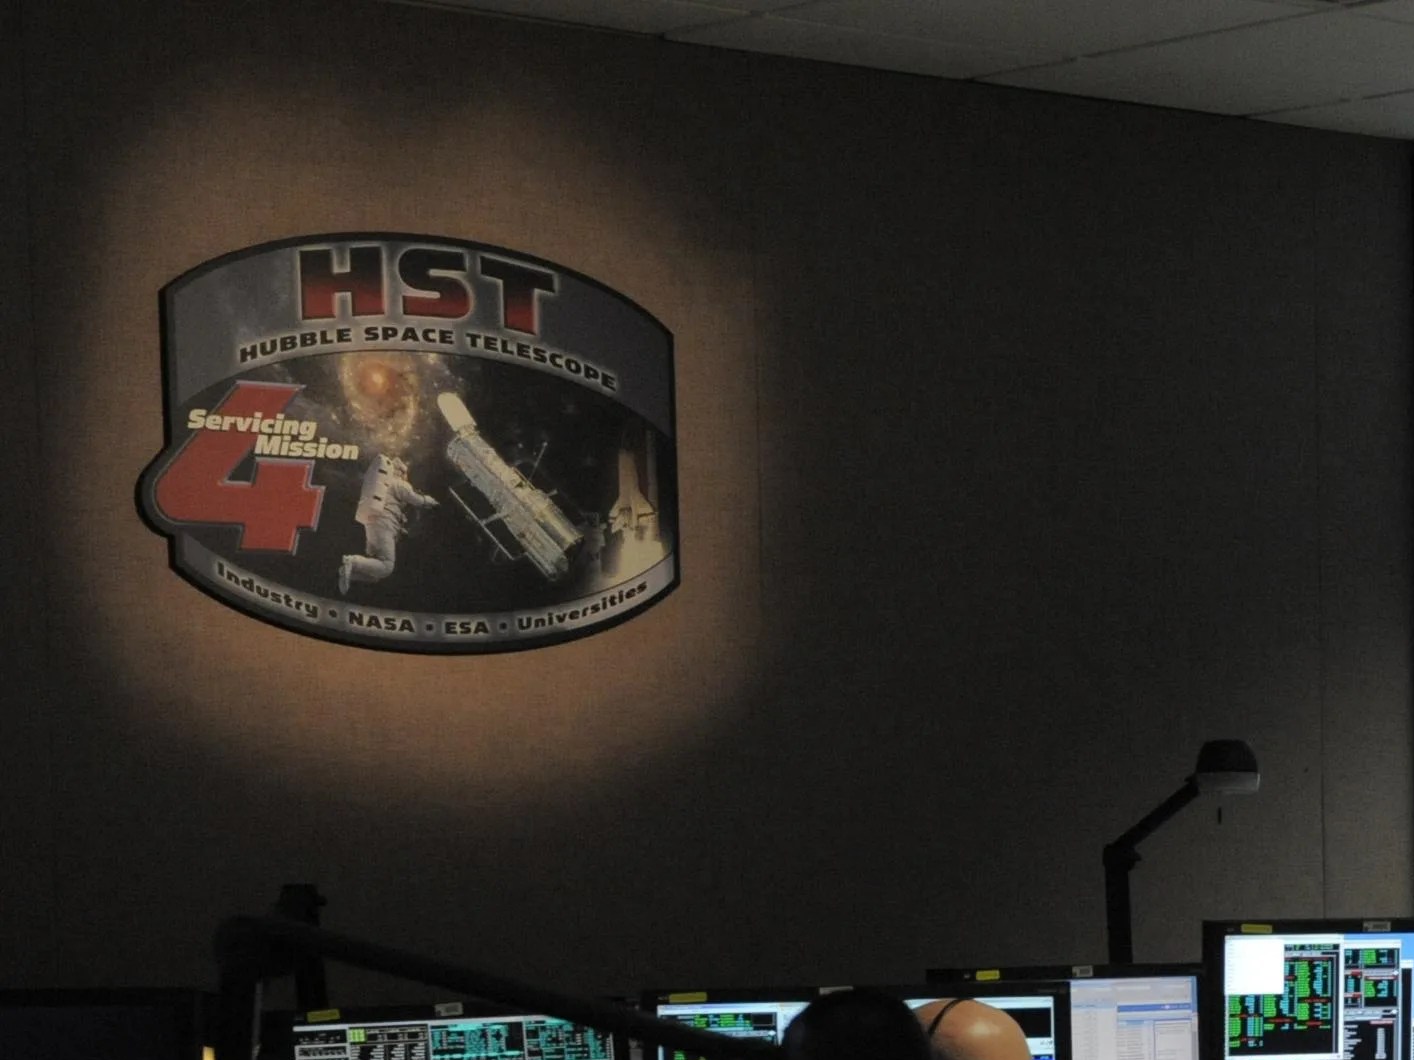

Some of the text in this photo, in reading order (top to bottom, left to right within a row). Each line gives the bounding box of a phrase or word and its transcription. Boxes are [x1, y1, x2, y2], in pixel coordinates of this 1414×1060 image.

[301, 246, 555, 334] HST
[239, 326, 617, 391] HUBBLE SPACE TELESCOPE
[187, 408, 318, 438] Servicing
[254, 435, 359, 460] Mission
[155, 380, 327, 554] 4
[217, 562, 649, 635] Industry NASA ESA Universities
